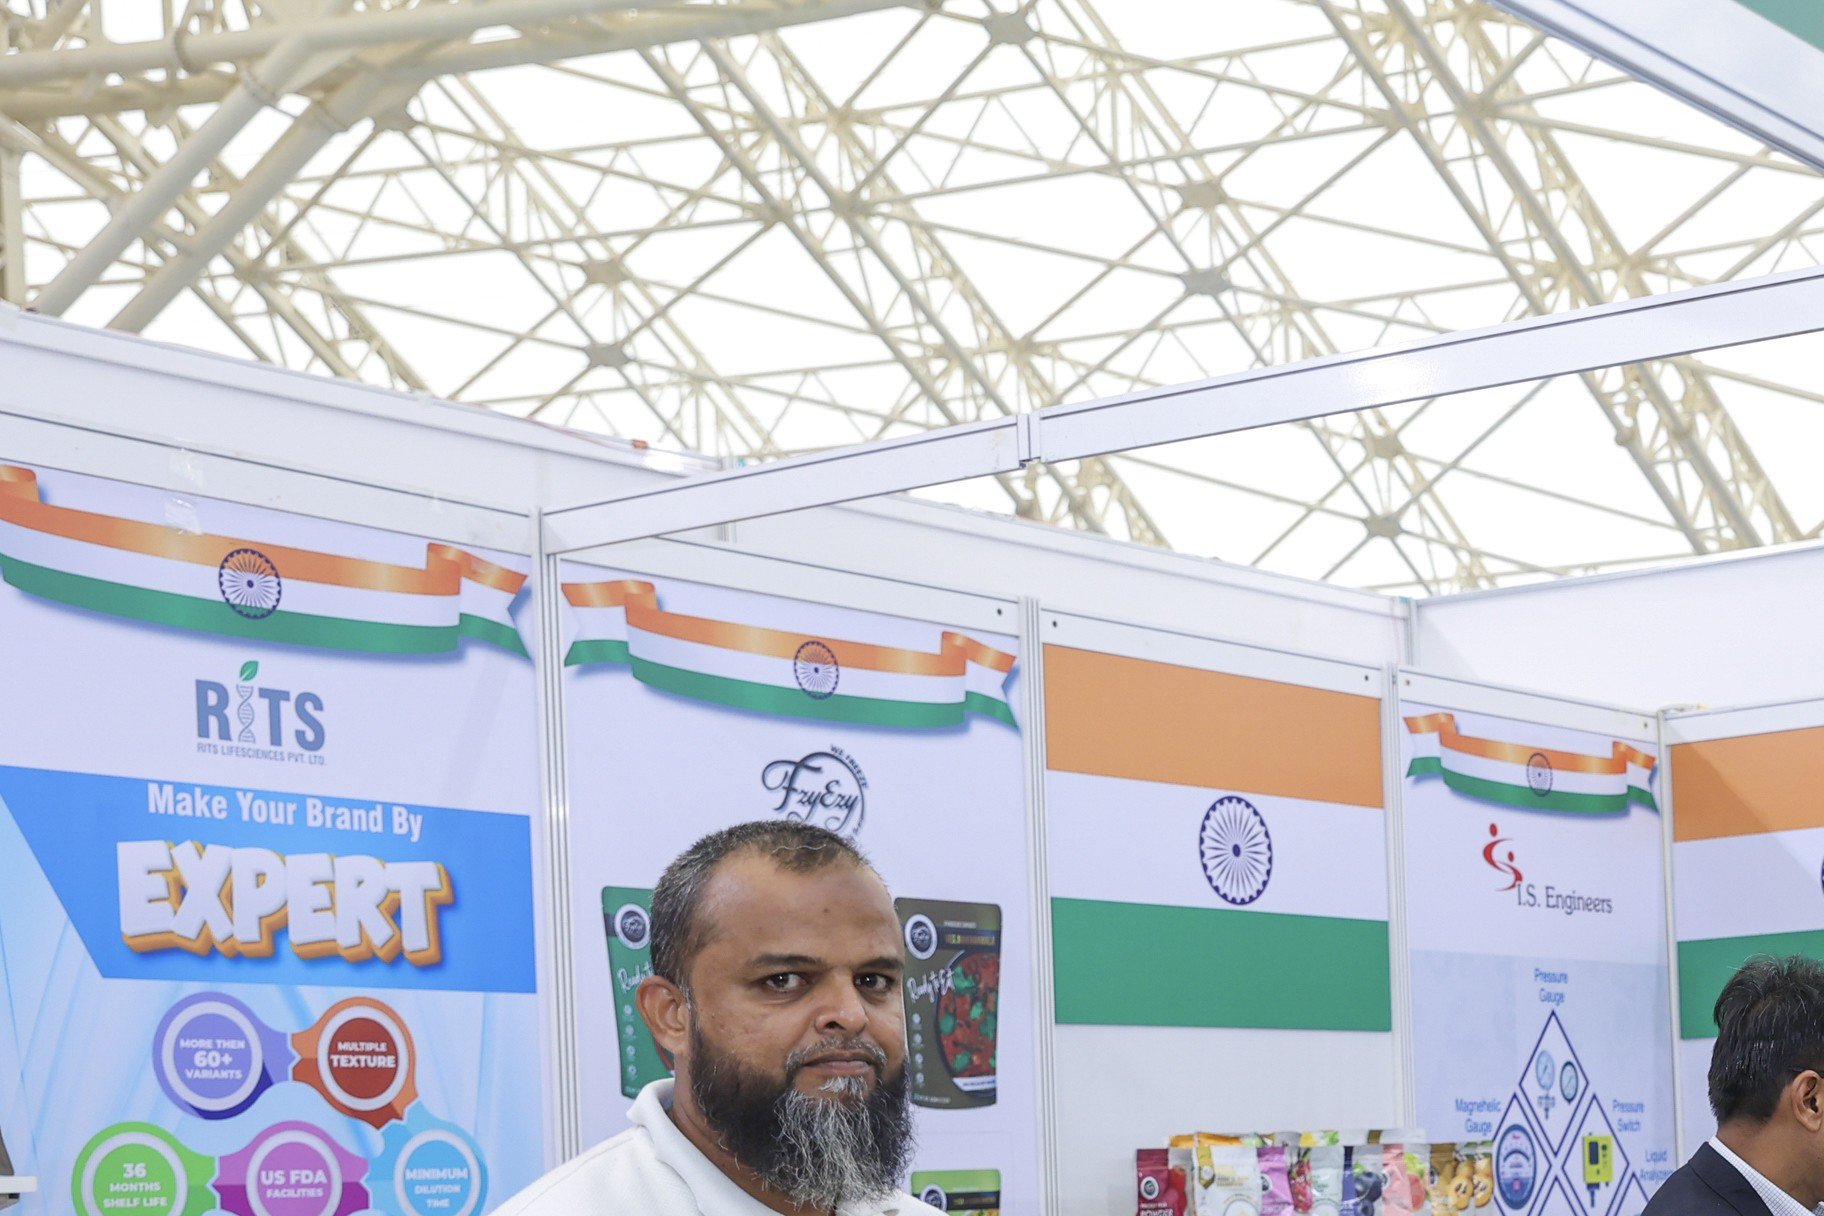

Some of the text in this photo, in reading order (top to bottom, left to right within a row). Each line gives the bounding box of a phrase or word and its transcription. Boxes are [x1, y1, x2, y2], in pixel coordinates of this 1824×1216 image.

[195, 661, 326, 752] RITS
[221, 745, 285, 761] LIFESCIENCES
[147, 782, 424, 841] Make Your Brand By
[117, 838, 455, 966] EXPERT
[1517, 883, 1613, 914] I.S. Engineers
[1534, 968, 1568, 984] Pressure
[1539, 988, 1565, 1006] Gauge
[180, 1038, 246, 1050] MORE THEN
[337, 1041, 387, 1052] MULTIPLE
[194, 1050, 233, 1068] 60+
[330, 1054, 396, 1068] TEXTURE
[184, 1068, 243, 1079] VARIANTS
[1455, 1098, 1501, 1115] Magnehelic
[1613, 1099, 1644, 1114] Pressure
[1465, 1118, 1492, 1136] Gauge
[1617, 1119, 1641, 1132] Switch
[1645, 1150, 1668, 1163] Liquid
[122, 1162, 147, 1178] 36
[260, 1169, 327, 1185] US FDA
[405, 1168, 468, 1181] MINIMUM
[109, 1182, 161, 1192] MONTHS
[266, 1188, 323, 1199] FACILITIES
[415, 1184, 461, 1195] DILUTION
[103, 1196, 168, 1208] SHELF LIFE
[426, 1199, 450, 1208] TIME
